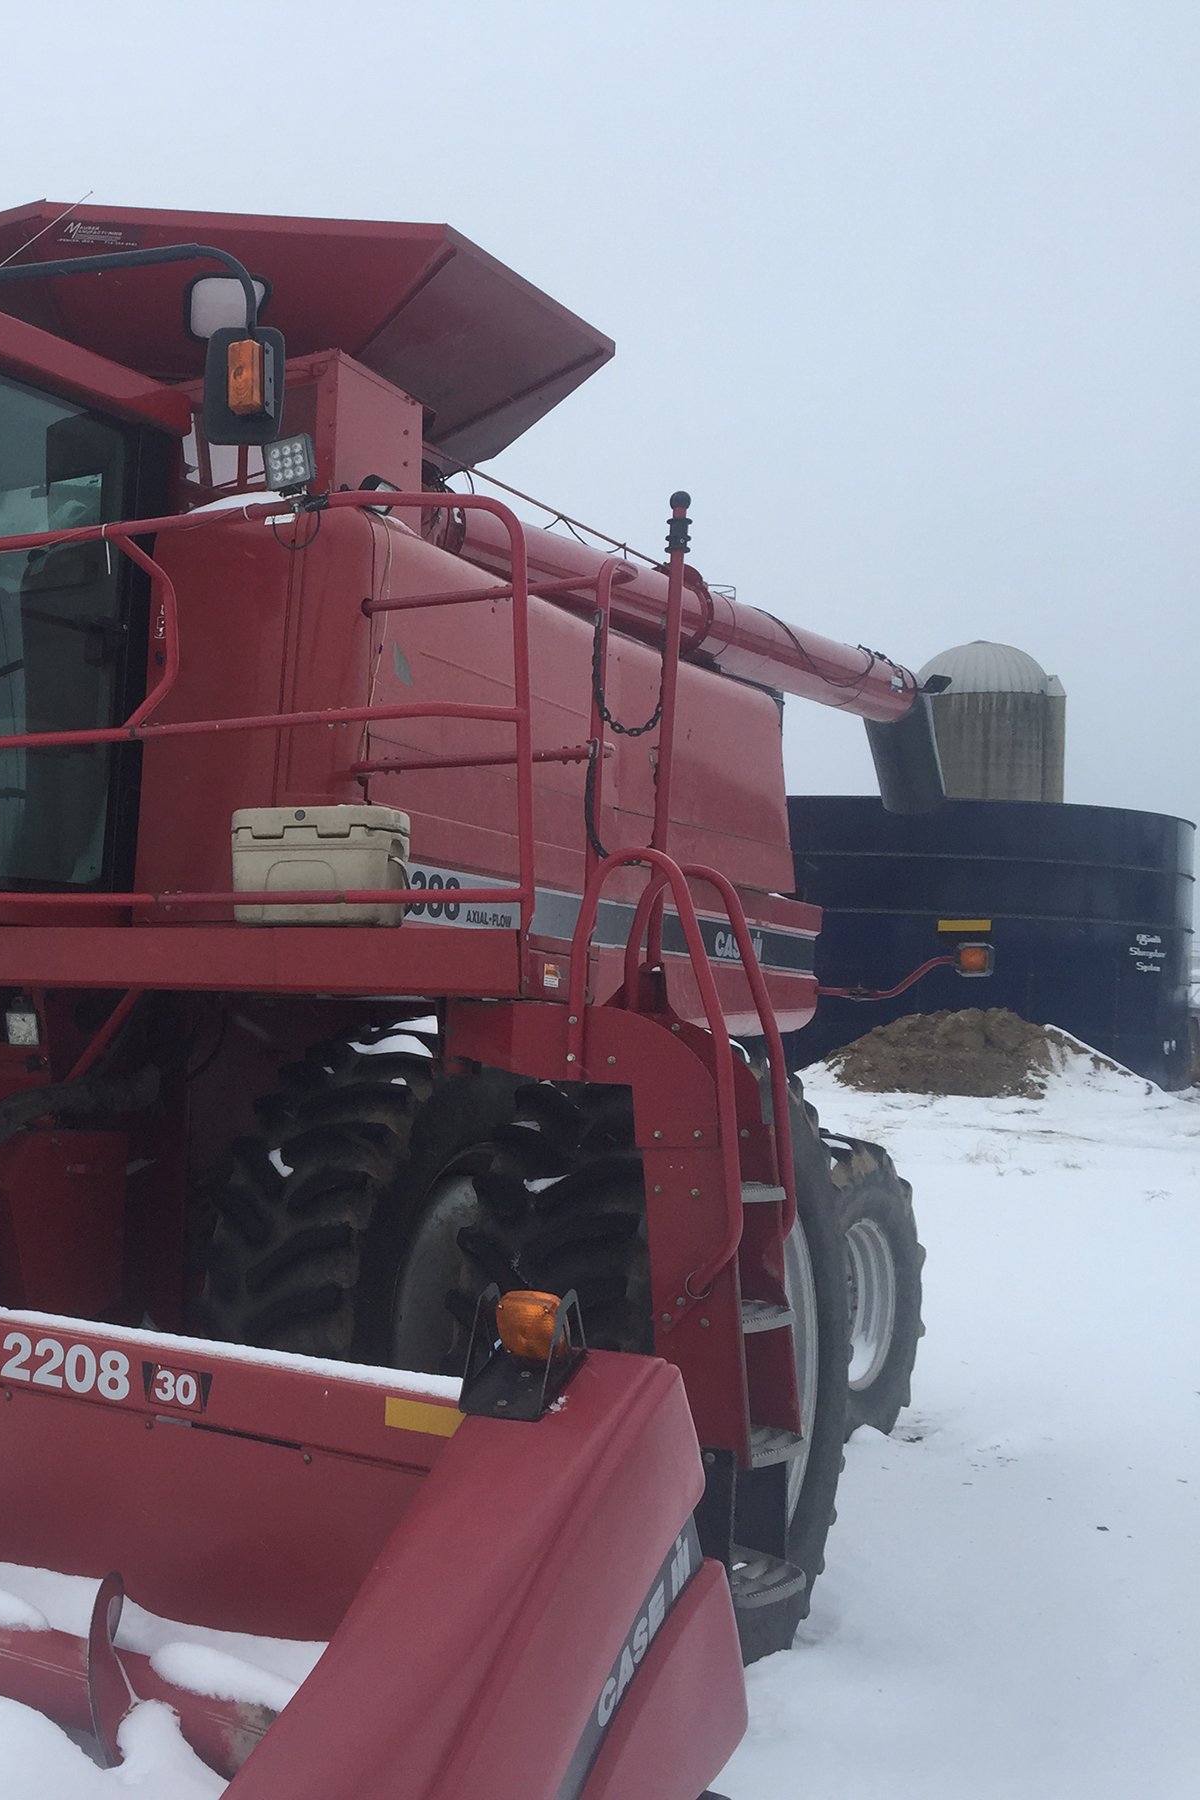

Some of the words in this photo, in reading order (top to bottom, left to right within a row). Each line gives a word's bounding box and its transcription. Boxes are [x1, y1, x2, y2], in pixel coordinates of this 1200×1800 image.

[466, 909, 513, 928] AXIAL-FLOW
[715, 931, 740, 959] CAS
[0, 1332, 130, 1400] 2208
[155, 1370, 197, 1405] 30
[598, 1580, 665, 1727] CASE
